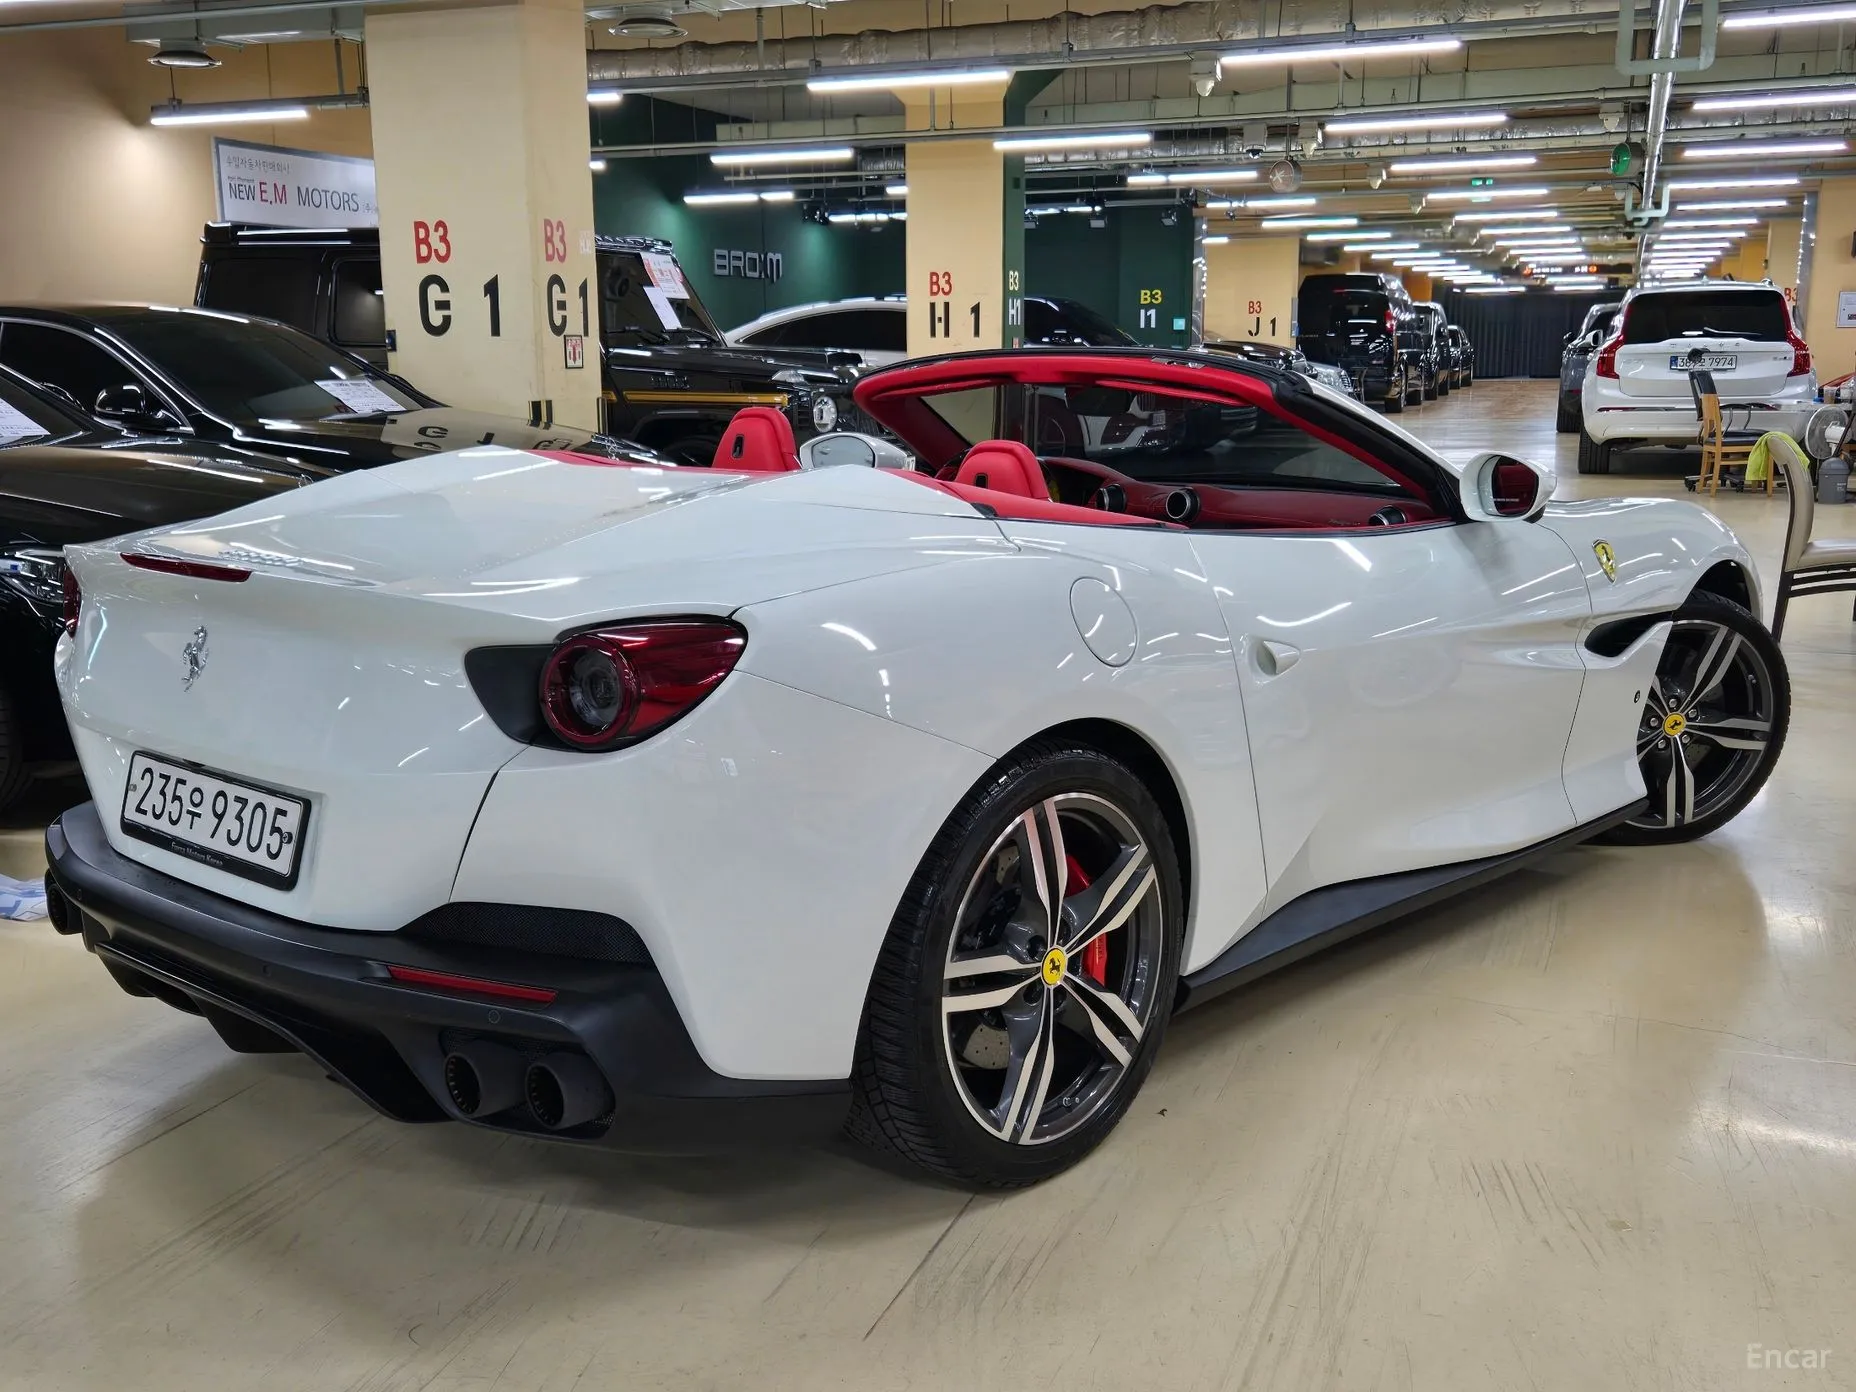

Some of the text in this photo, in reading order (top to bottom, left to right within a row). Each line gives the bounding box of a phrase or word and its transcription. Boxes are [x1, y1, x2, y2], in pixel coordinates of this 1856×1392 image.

[228, 182, 256, 201] NEW
[297, 186, 360, 213] MOTORS
[414, 220, 452, 264] B3
[544, 218, 567, 263] B3
[929, 271, 953, 296] B3
[1008, 270, 1019, 291] B3
[419, 273, 500, 337] G 1
[1140, 289, 1163, 304] B3
[1248, 300, 1262, 314] B3
[929, 301, 980, 338] H 1
[1008, 298, 1020, 326] H1
[1247, 316, 1277, 337] J 1
[1709, 356, 1734, 367] 7974
[135, 767, 288, 860] 235우 9305
